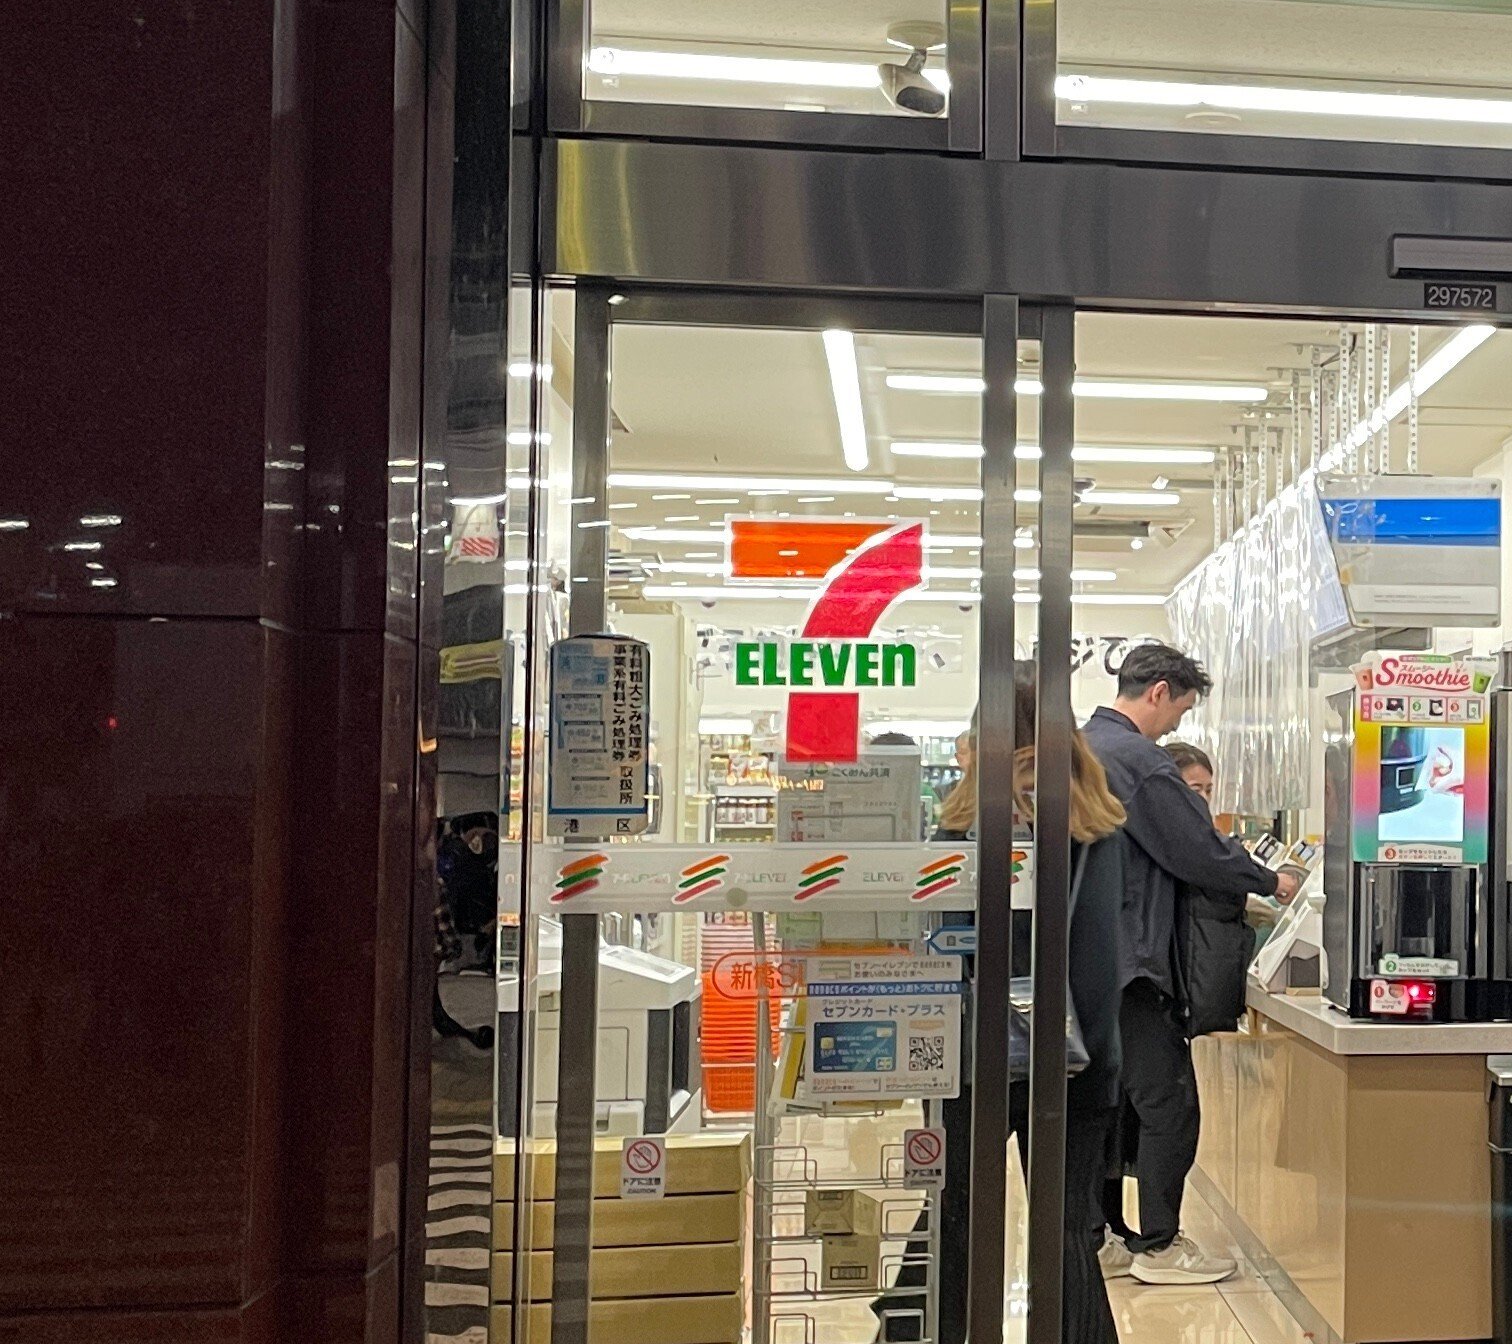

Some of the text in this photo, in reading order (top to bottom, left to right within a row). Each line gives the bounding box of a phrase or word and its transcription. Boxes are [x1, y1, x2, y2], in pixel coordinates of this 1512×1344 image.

[1428, 286, 1493, 308] 297572
[1375, 657, 1471, 687] Smoothie
[822, 1004, 945, 1018] セブンカード・プラス
